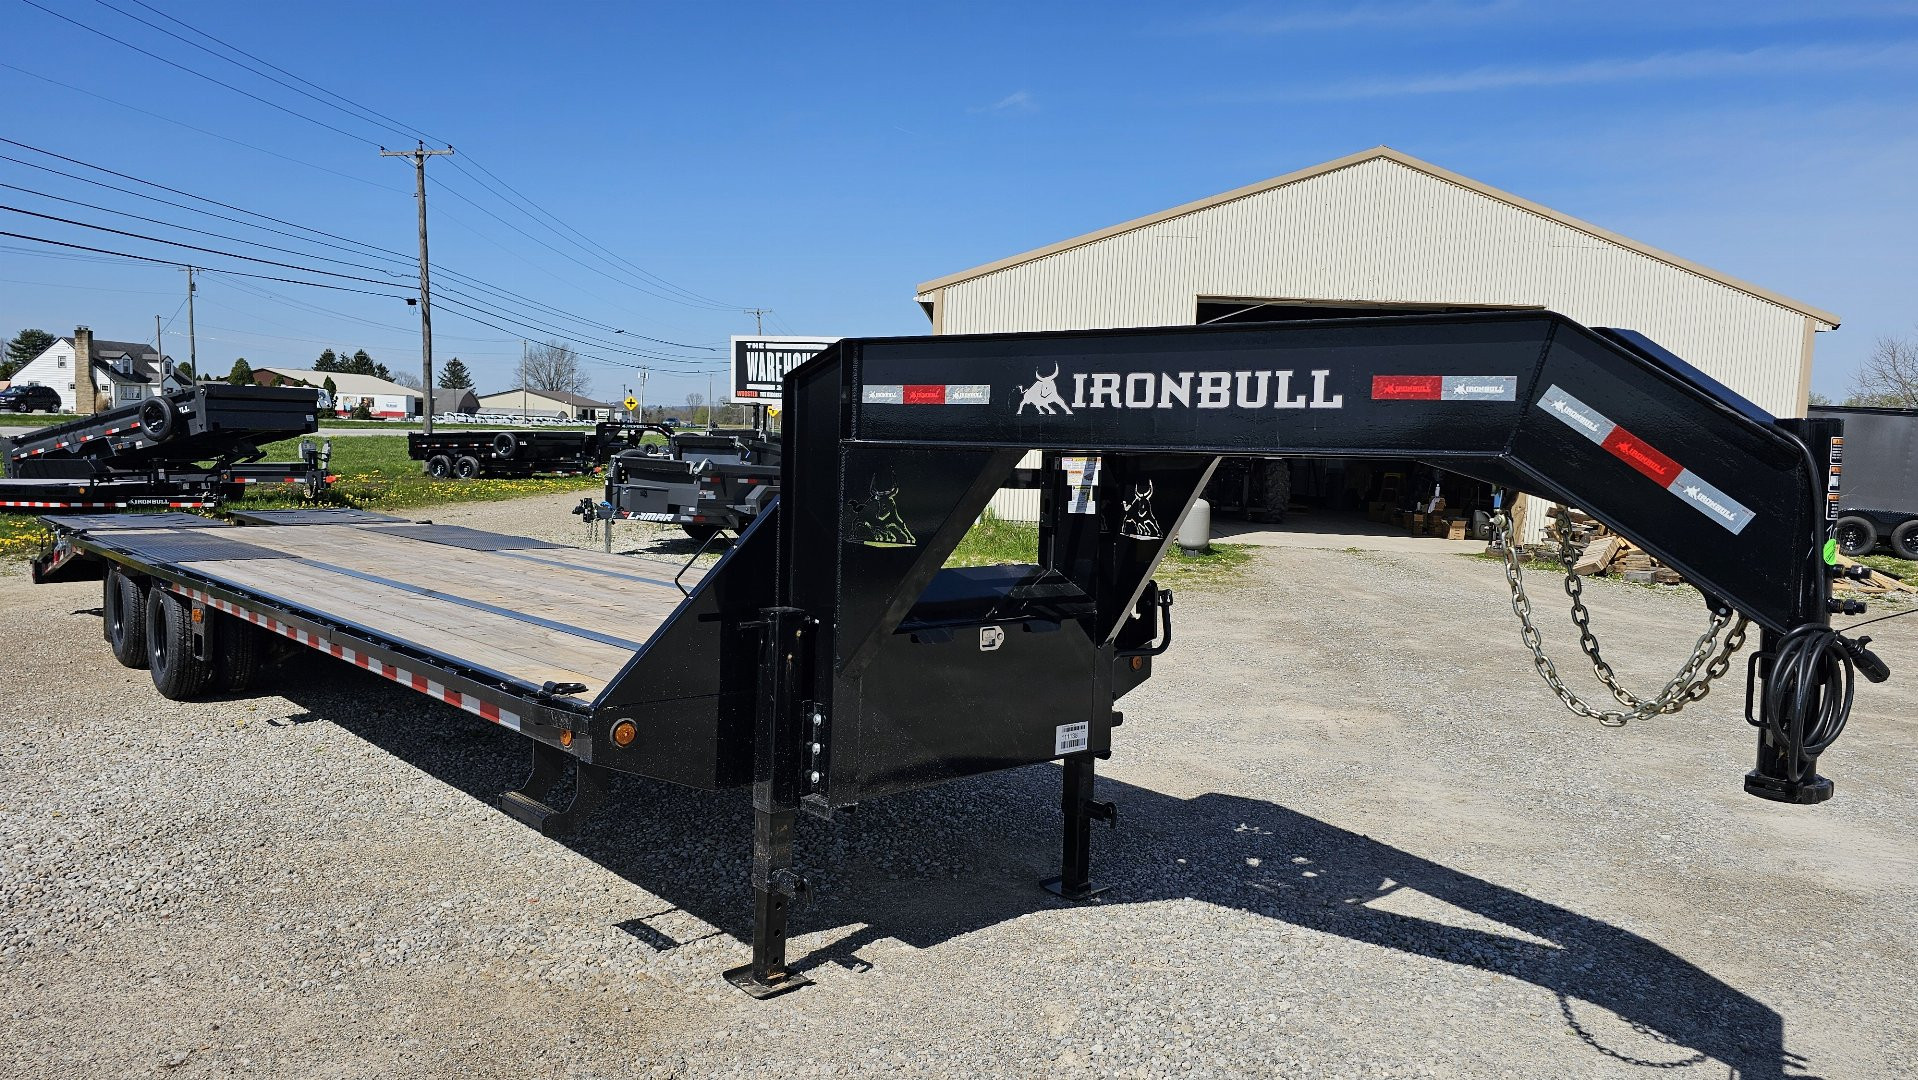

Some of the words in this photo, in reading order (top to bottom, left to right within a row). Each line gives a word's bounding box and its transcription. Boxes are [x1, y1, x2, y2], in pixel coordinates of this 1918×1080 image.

[746, 352, 818, 382] WAREHO
[1072, 369, 1343, 409] IRONBULL
[1563, 406, 1598, 432] IRONBULL
[1629, 448, 1668, 475] IRONBULL
[626, 511, 675, 522] LAMAR
[1697, 492, 1737, 521] IRONBULL
